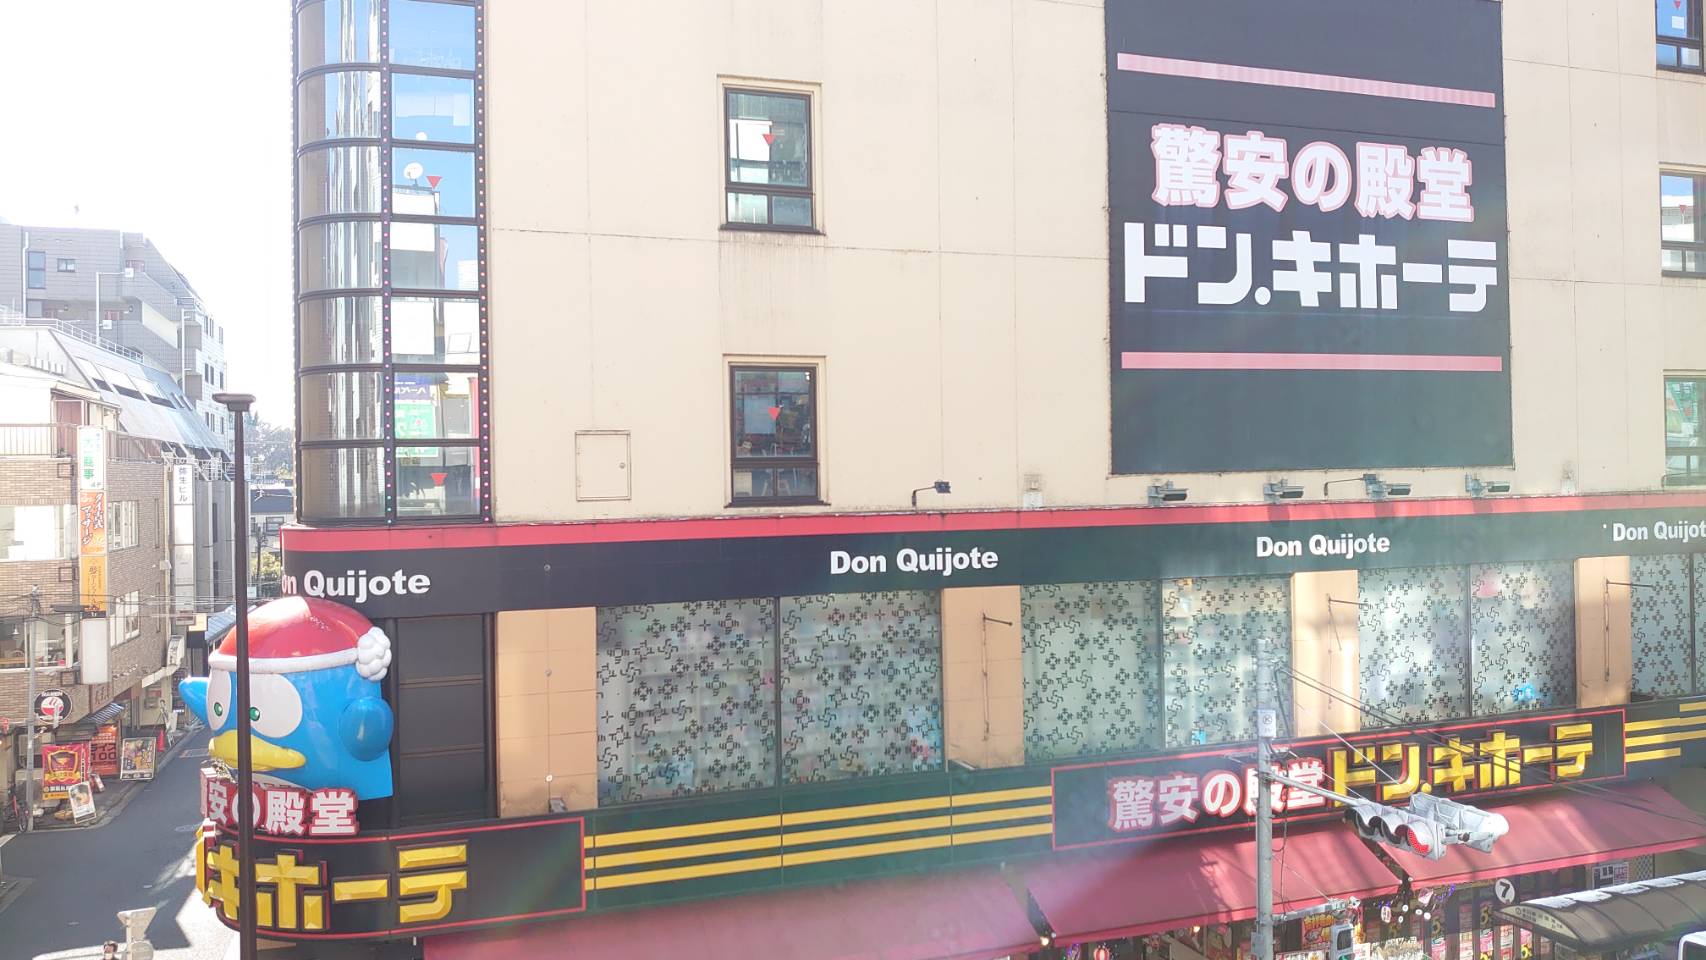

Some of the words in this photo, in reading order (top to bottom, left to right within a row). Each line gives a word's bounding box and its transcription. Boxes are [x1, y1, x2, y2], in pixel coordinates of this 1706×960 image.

[1150, 122, 1475, 222] 驚安の殿堂
[1256, 536, 1303, 558] Don
[1308, 532, 1391, 560] Quijote
[1612, 522, 1649, 542] Don
[829, 550, 887, 575] Don
[896, 546, 999, 577] Quijote
[303, 568, 431, 604] Quijote
[1499, 881, 1511, 898] 7
